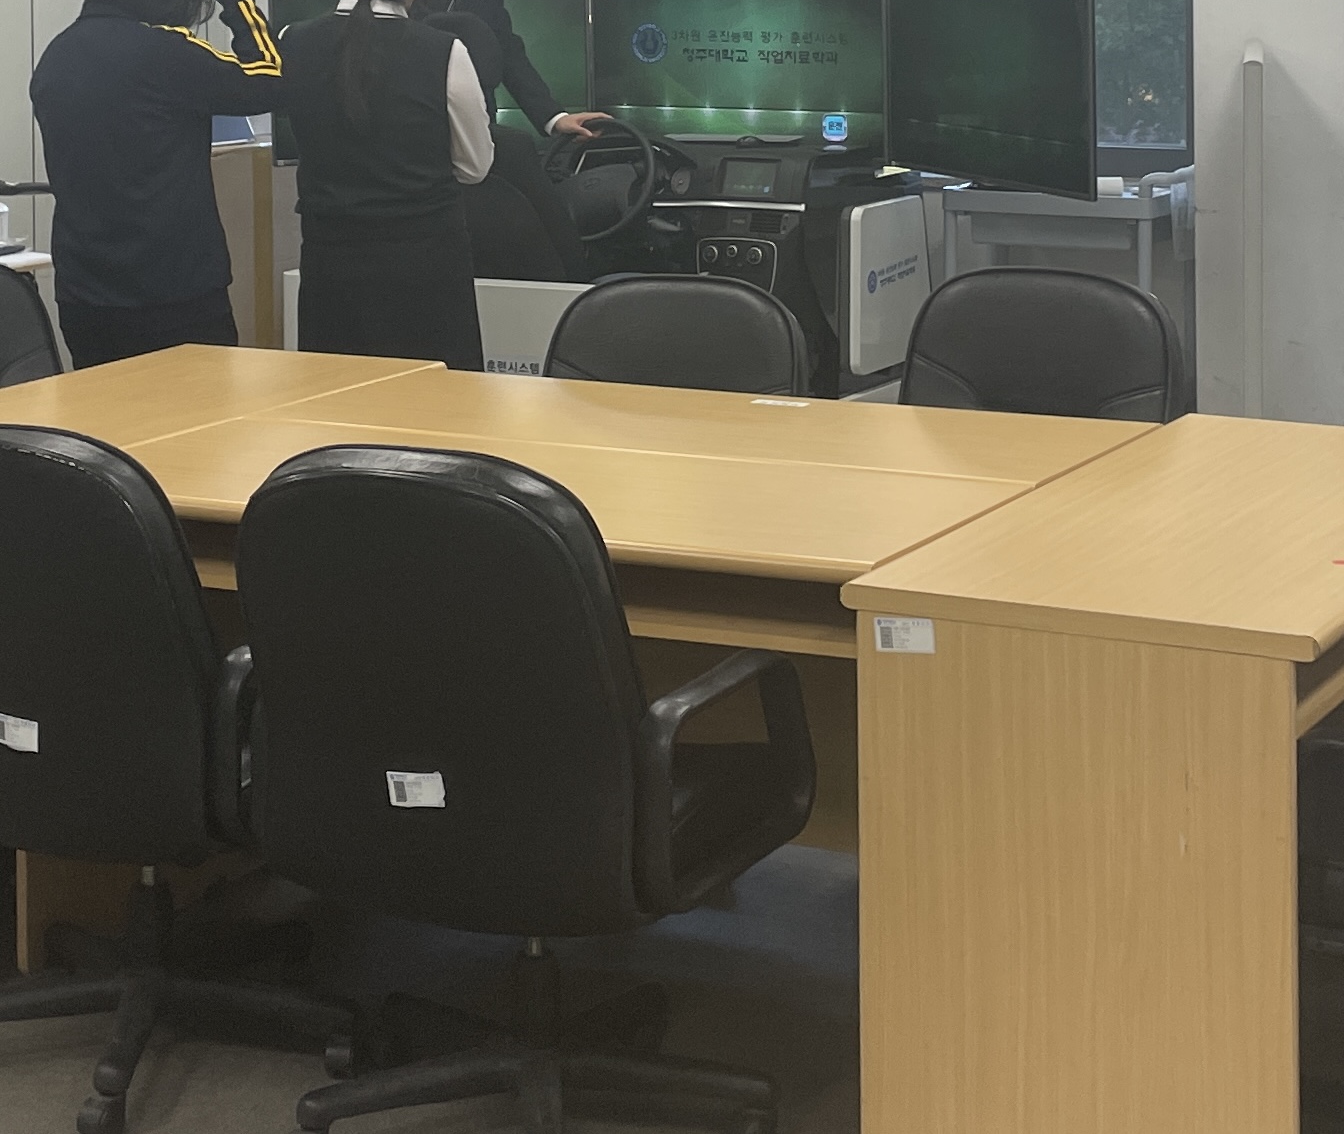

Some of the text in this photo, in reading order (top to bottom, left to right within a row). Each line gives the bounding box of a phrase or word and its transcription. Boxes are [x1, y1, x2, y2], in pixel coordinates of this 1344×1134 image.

[671, 29, 700, 43] 3차원
[760, 30, 783, 44] 평가
[790, 31, 849, 46] 훈련시스템
[682, 47, 838, 65] 청주대학교 작업치료학과
[486, 359, 540, 375] 훈련시스템
